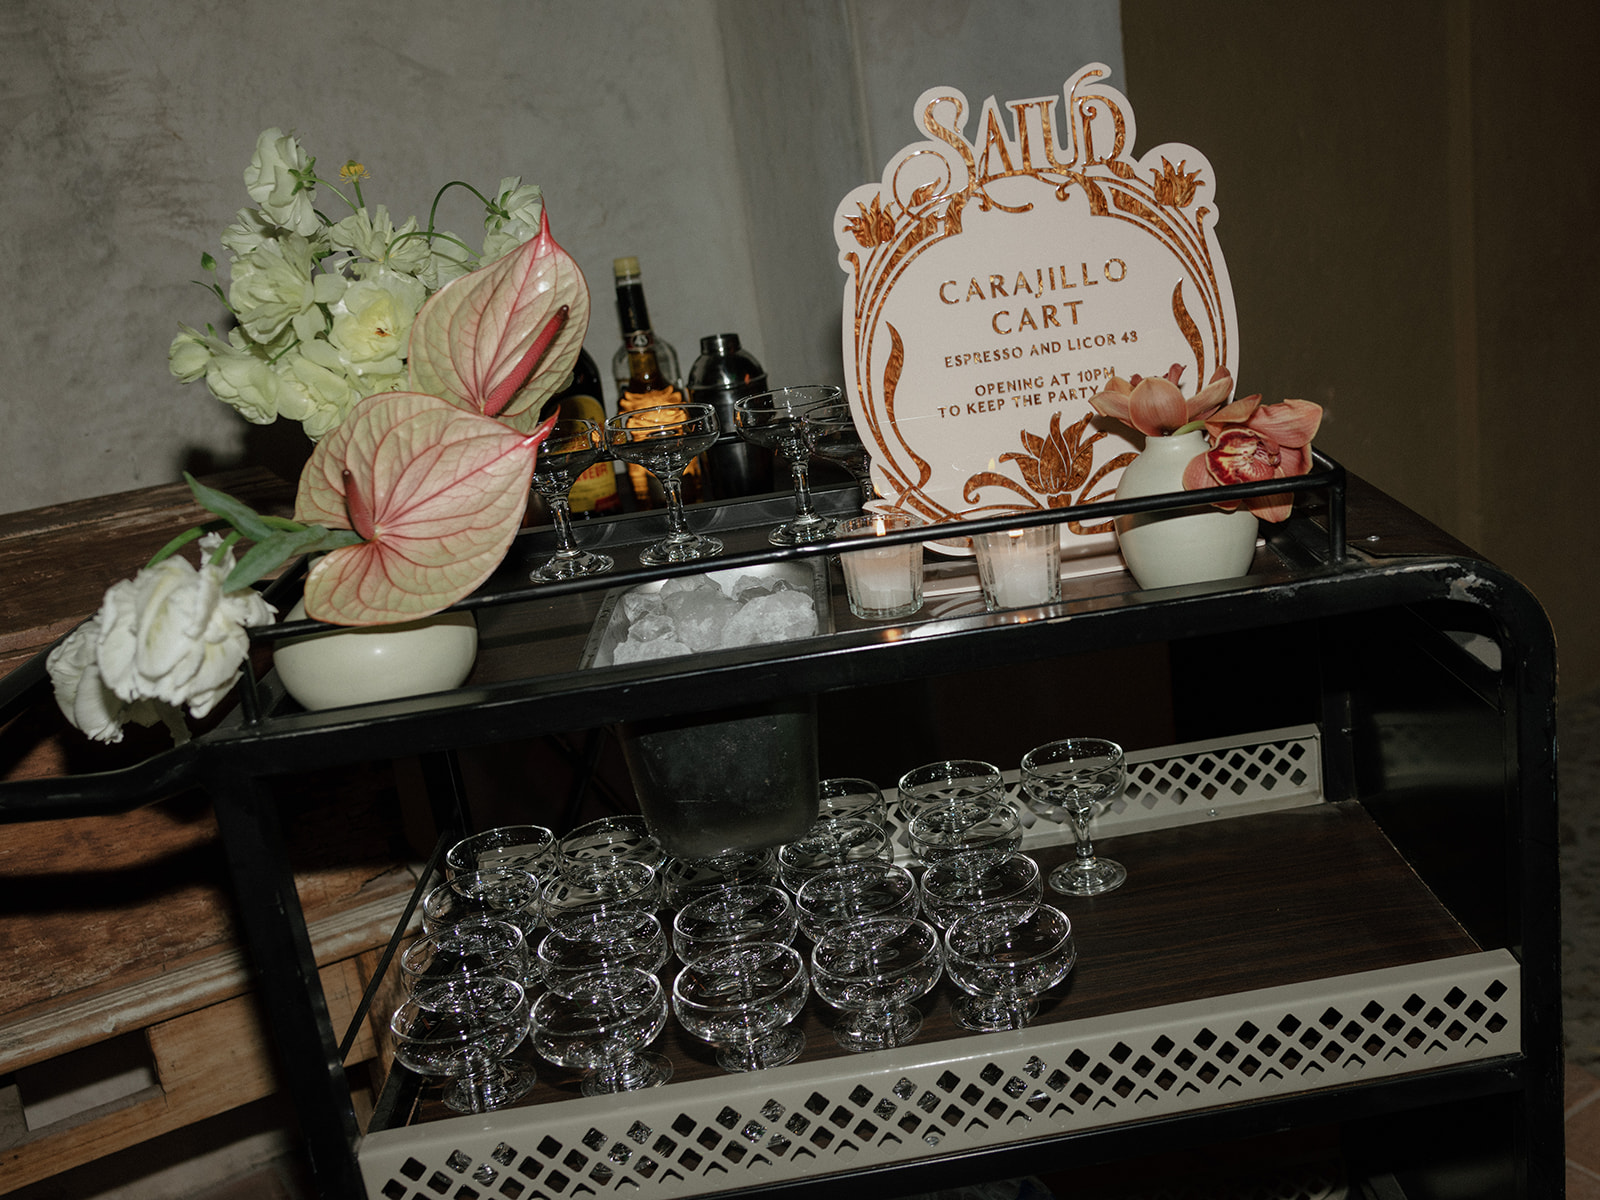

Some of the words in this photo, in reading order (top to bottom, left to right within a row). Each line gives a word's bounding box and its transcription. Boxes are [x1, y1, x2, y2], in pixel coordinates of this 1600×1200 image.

[939, 258, 1127, 305] CARAJILLO
[992, 300, 1083, 335] CART
[945, 346, 1023, 368] ESPRESSO
[1030, 341, 1061, 357] AND
[1067, 333, 1116, 351] LICOR
[975, 376, 1044, 396] OPENING
[1050, 372, 1070, 386] AT
[1077, 366, 1115, 383] 10PM
[937, 404, 960, 418] TO
[966, 399, 1005, 415] KEEP
[1012, 393, 1042, 408] THE
[1048, 385, 1099, 403] PARTY
